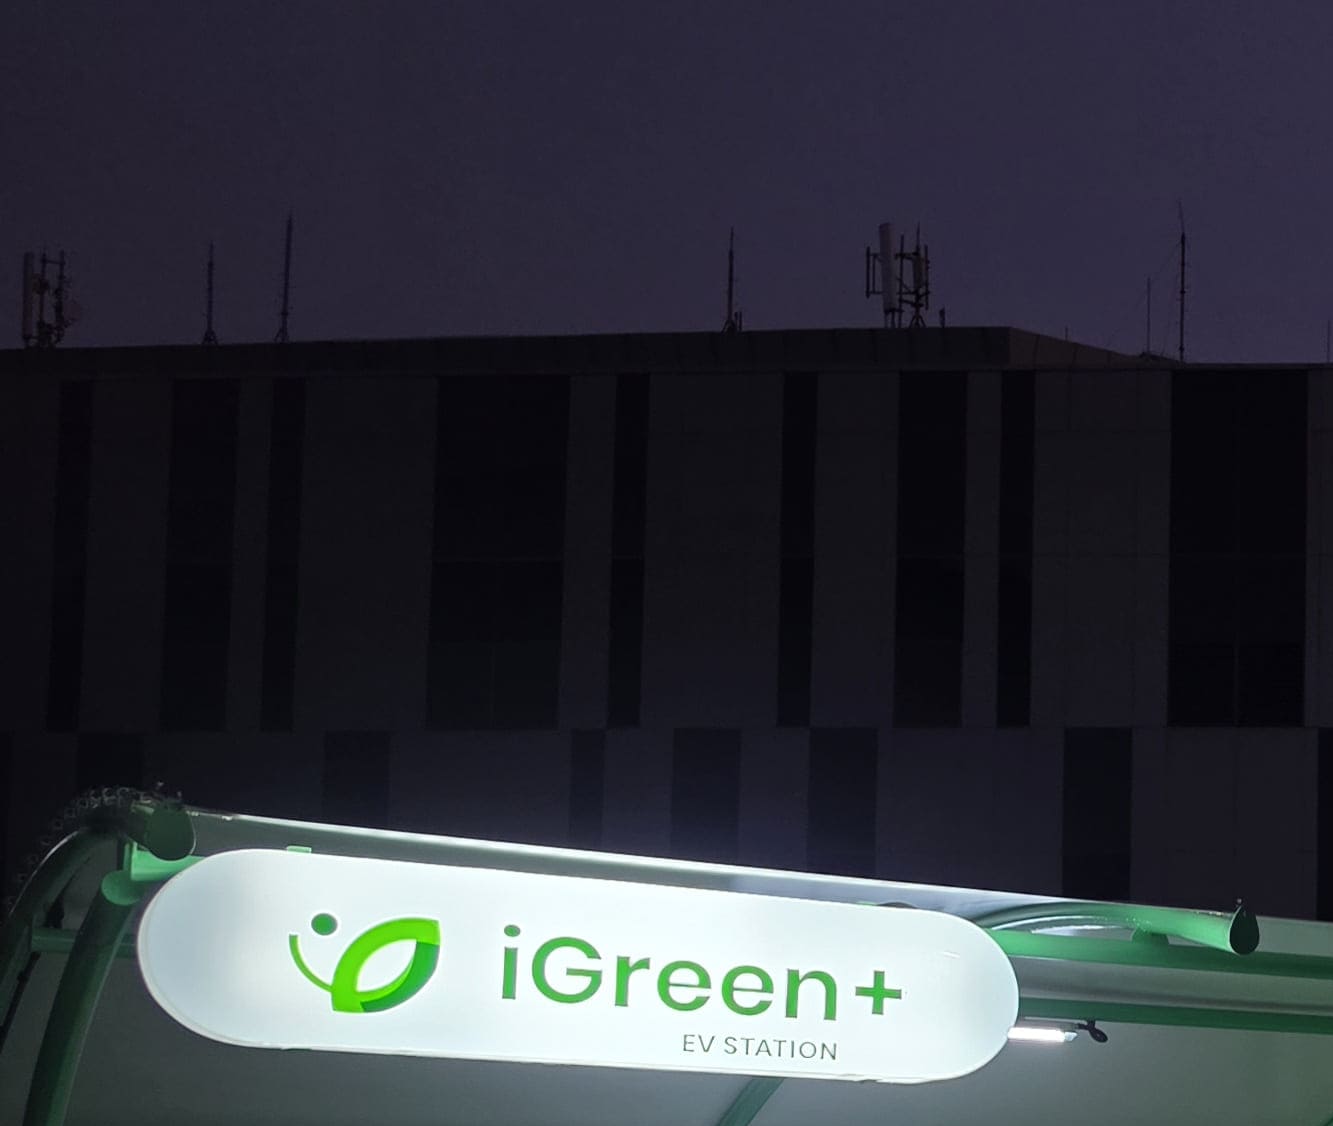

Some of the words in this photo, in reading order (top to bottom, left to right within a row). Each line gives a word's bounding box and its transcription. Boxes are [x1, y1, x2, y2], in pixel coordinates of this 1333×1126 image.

[501, 924, 903, 1021] iGreen+
[682, 1034, 716, 1053] EV
[724, 1036, 838, 1061] STATION
